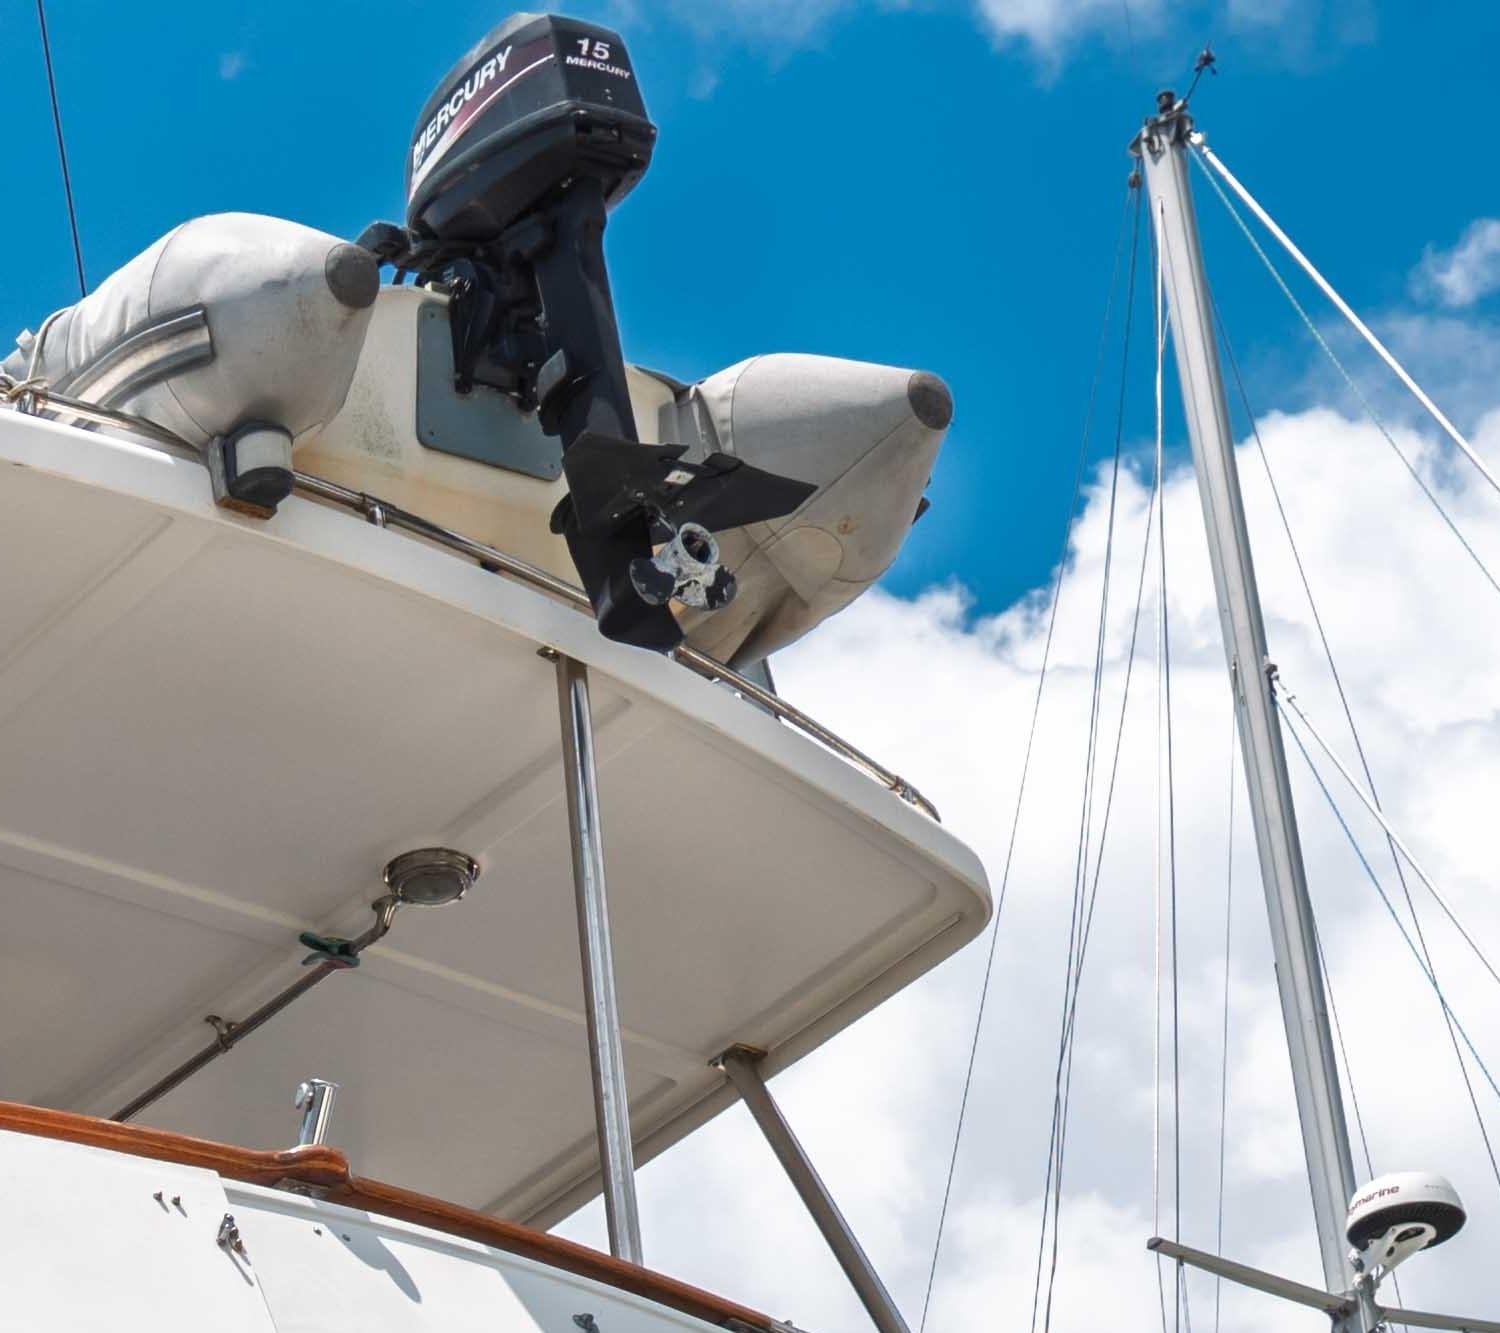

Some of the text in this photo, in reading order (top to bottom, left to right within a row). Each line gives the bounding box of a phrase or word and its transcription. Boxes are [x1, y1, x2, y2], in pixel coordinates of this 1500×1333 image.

[577, 37, 610, 61] 15
[566, 55, 631, 80] MERCURY
[413, 45, 513, 170] MERCURY
